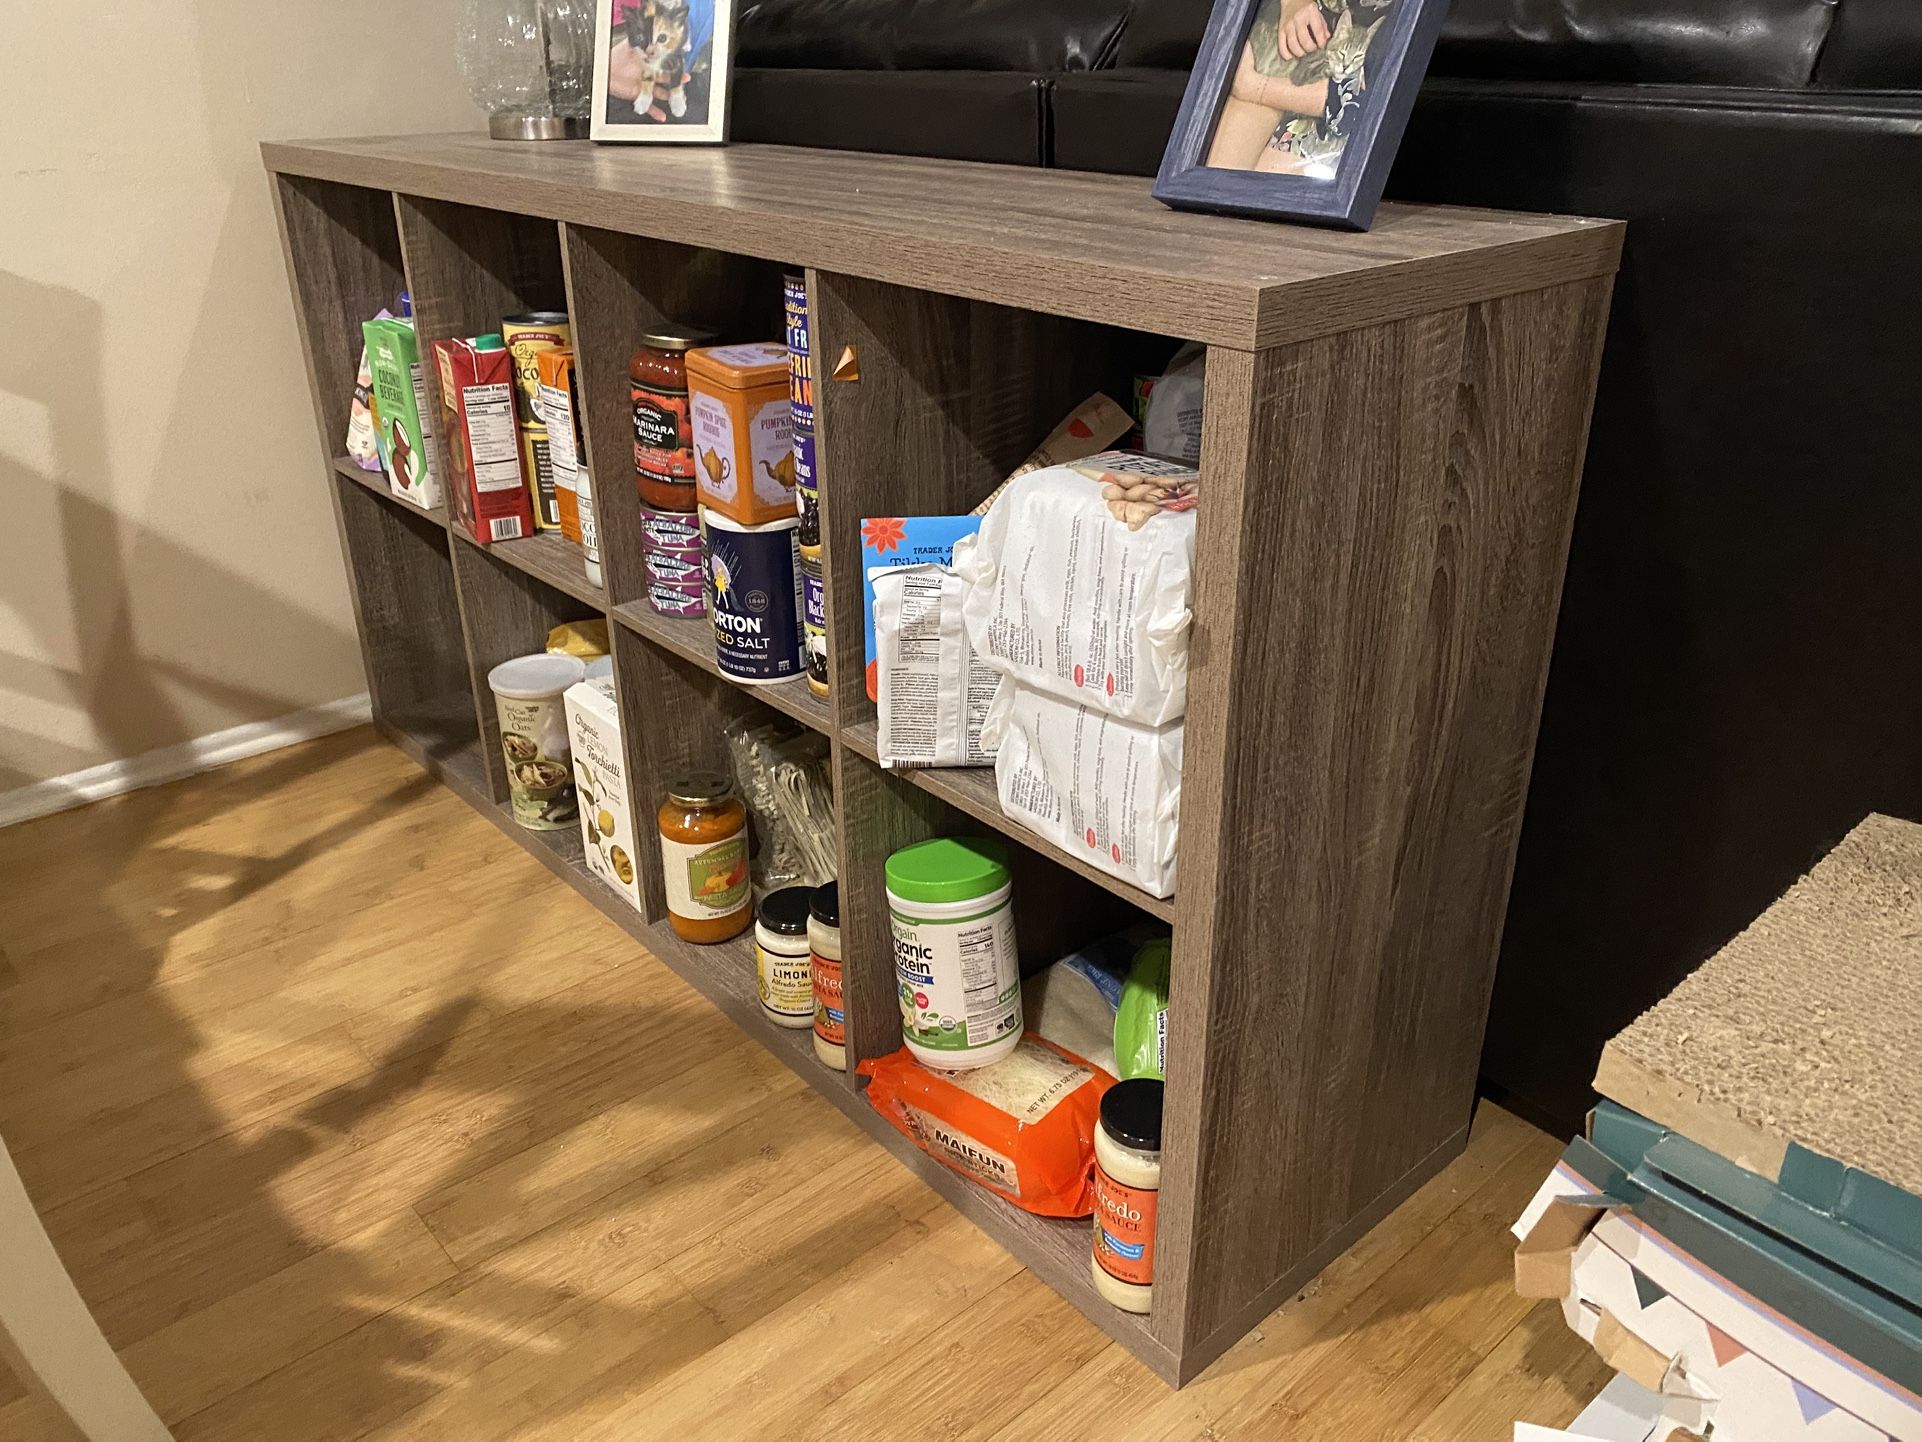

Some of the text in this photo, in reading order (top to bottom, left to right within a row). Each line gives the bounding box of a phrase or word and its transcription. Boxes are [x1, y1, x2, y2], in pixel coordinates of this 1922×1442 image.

[463, 386, 490, 394] Nutrition
[637, 408, 662, 421] ORGANIC
[638, 428, 663, 442] SAUCE
[662, 534, 684, 542] TUNA
[660, 568, 680, 578] TUNA
[905, 575, 936, 584] Nutrition
[660, 601, 681, 610] TUNA
[713, 606, 760, 634] ORTON
[716, 630, 770, 649] ZED SALT
[508, 712, 535, 723] Organic
[512, 722, 531, 731] Oats
[575, 714, 599, 740] Organic
[587, 744, 620, 778] Torchietti
[958, 929, 980, 938] Nutrition
[895, 952, 930, 974] rotein
[772, 978, 795, 988] Alfredo
[908, 974, 926, 982] BOOST
[1026, 1104, 1039, 1115] NET
[1038, 1092, 1049, 1104] WT.
[1049, 1080, 1062, 1094] 6.75
[935, 1128, 1005, 1174] MAIFUN
[1096, 1184, 1142, 1222] fredo
[1106, 1212, 1141, 1232] SAUCE
